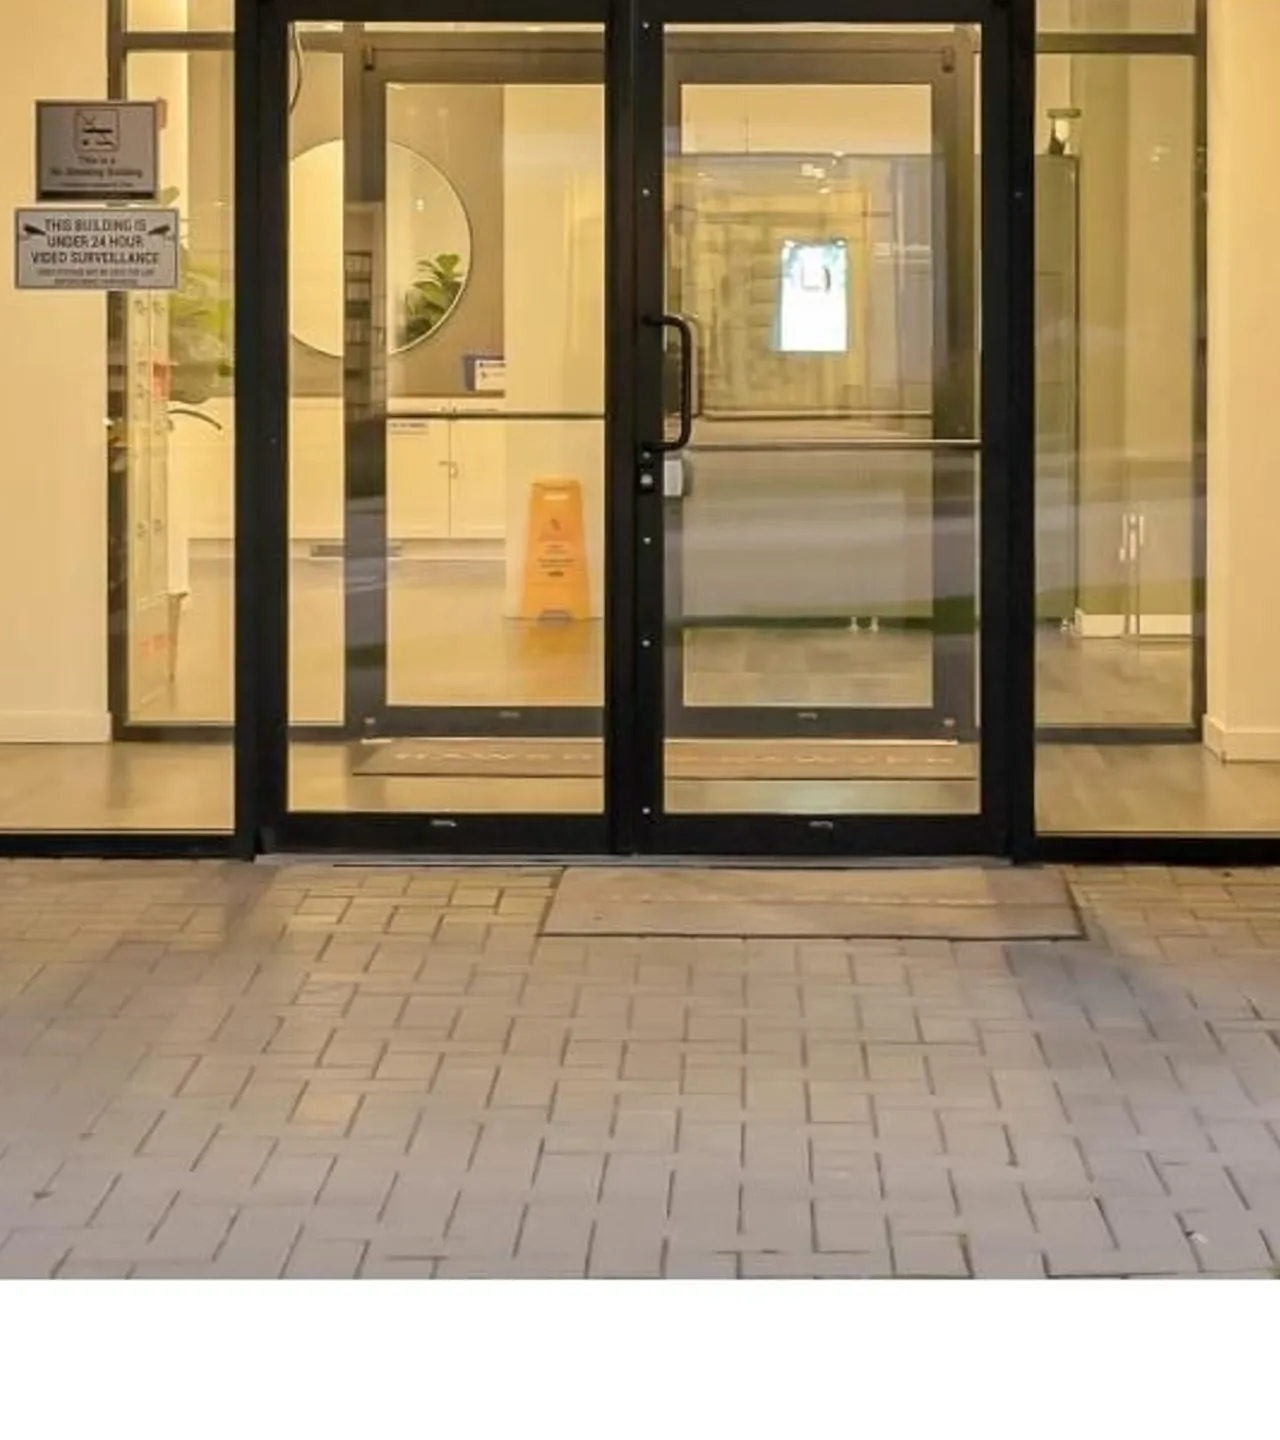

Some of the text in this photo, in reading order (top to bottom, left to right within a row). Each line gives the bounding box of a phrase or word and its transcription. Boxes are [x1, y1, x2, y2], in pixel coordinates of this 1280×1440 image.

[45, 218, 147, 231] THIS BUILDING IS
[46, 234, 143, 248] UNDER 24 HOUR
[30, 251, 160, 264] VIDEO SURVEILLANCE
